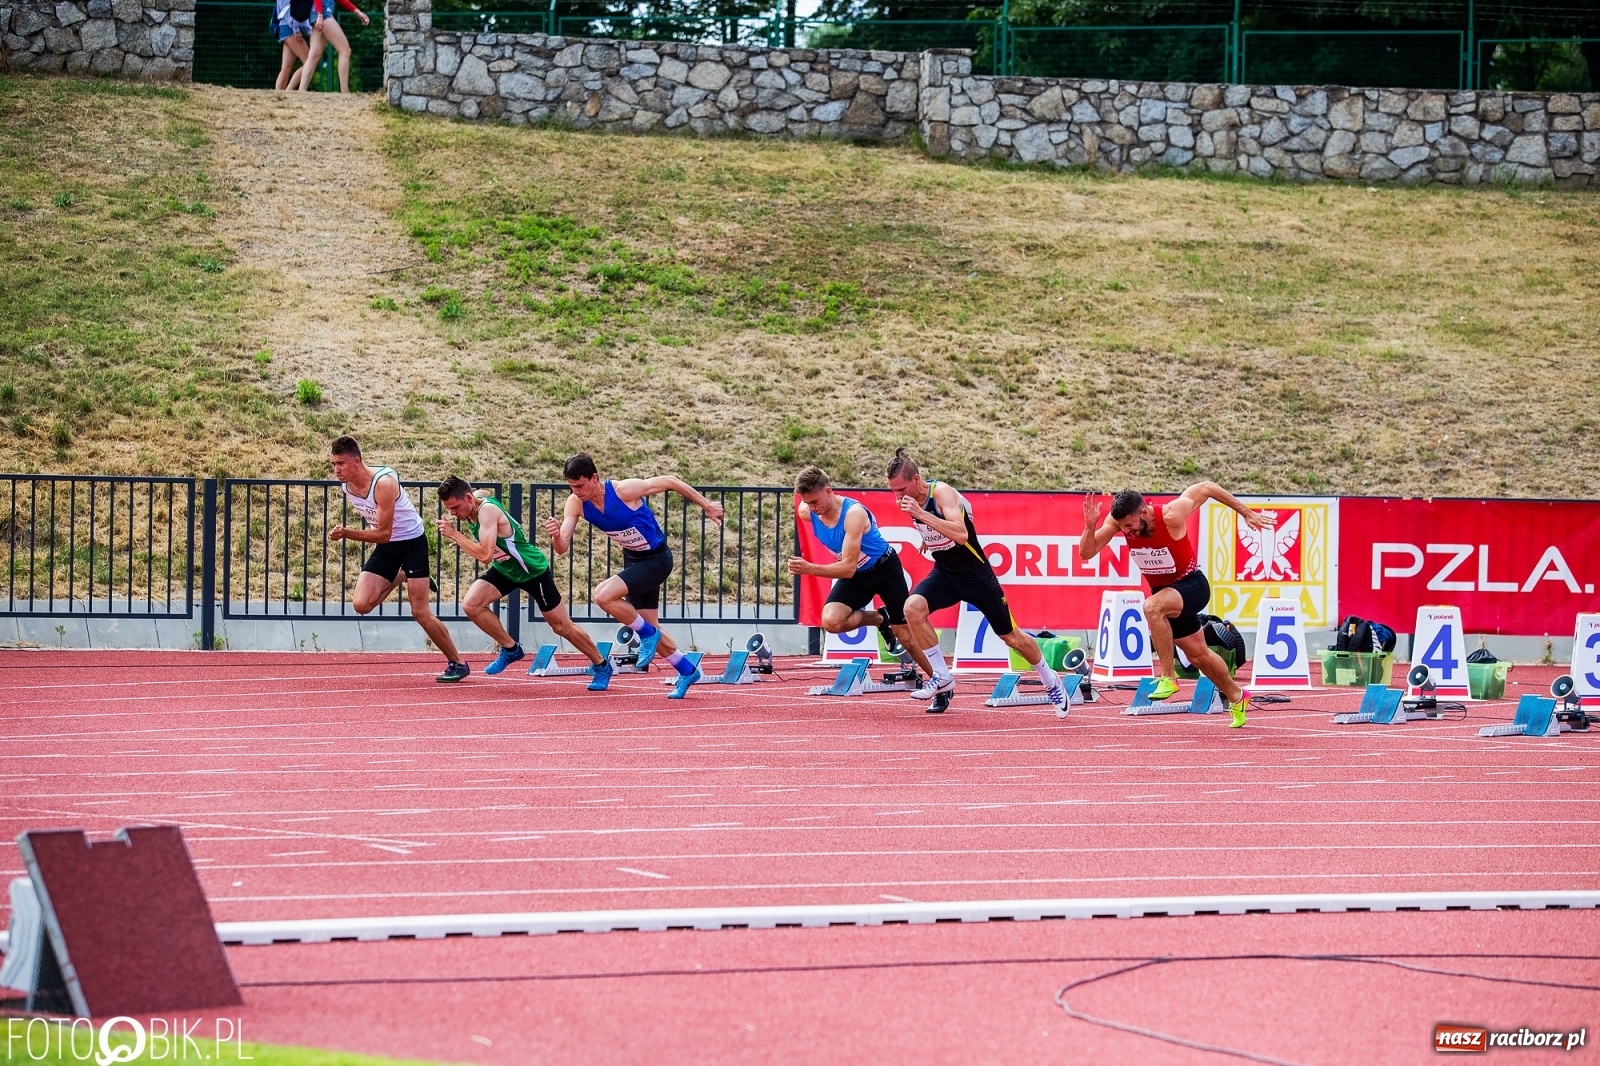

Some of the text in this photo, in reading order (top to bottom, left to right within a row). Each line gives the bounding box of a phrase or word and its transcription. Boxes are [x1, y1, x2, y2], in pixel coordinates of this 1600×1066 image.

[620, 528, 637, 537] 282
[1150, 548, 1168, 557] 625
[987, 542, 1130, 578] ORLEN
[1214, 587, 1319, 620] PZA
[1099, 608, 1111, 660] 6
[1119, 608, 1144, 661] 6
[1265, 616, 1298, 670] 5
[1421, 624, 1458, 680] 4
